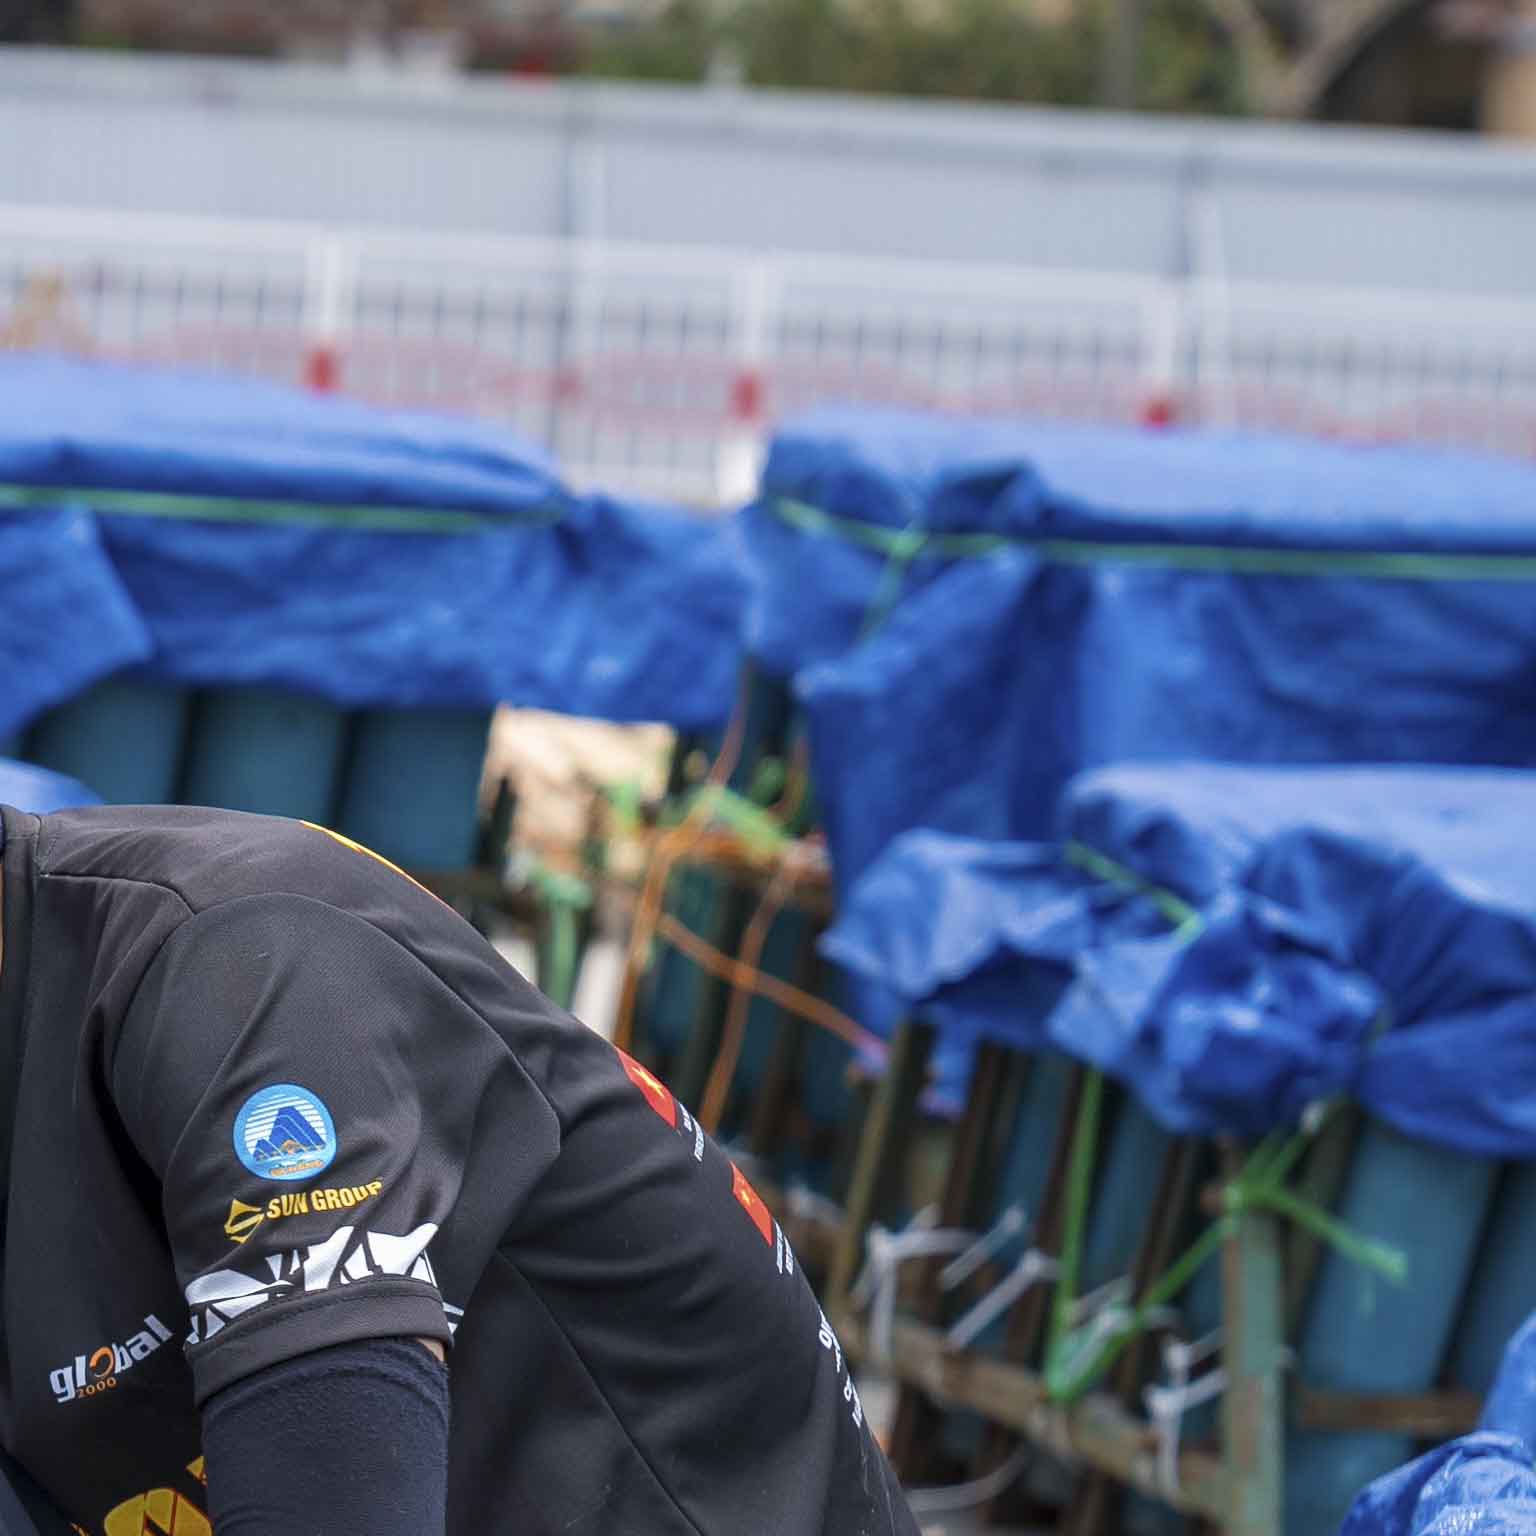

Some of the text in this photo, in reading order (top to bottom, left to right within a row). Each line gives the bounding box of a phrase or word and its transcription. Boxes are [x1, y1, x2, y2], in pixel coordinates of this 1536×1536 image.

[266, 1180, 383, 1220] SUN GROUP
[49, 1313, 174, 1403] global
[76, 1376, 117, 1399] 2000
